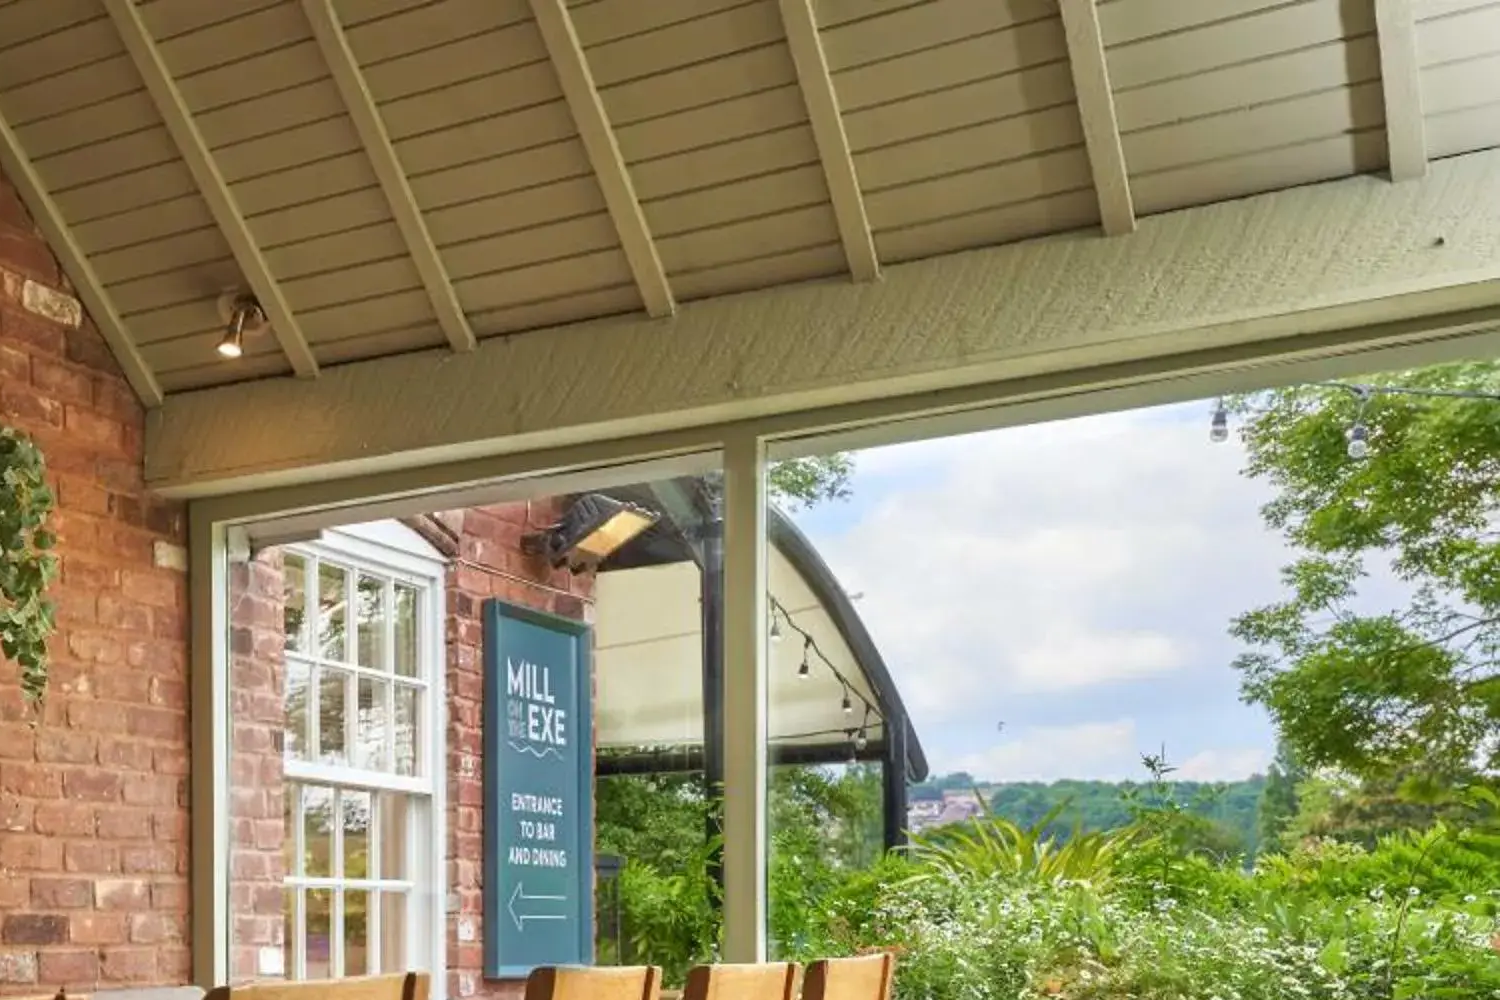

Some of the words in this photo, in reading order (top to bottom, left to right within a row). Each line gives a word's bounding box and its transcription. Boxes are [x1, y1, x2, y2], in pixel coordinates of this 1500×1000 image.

[507, 656, 555, 704] MILL
[528, 703, 566, 745] EXE
[511, 793, 564, 816] ENTRANCE
[520, 821, 534, 838] TO
[536, 822, 556, 841] BAR
[508, 847, 530, 866] AND
[533, 849, 567, 868] DINING
